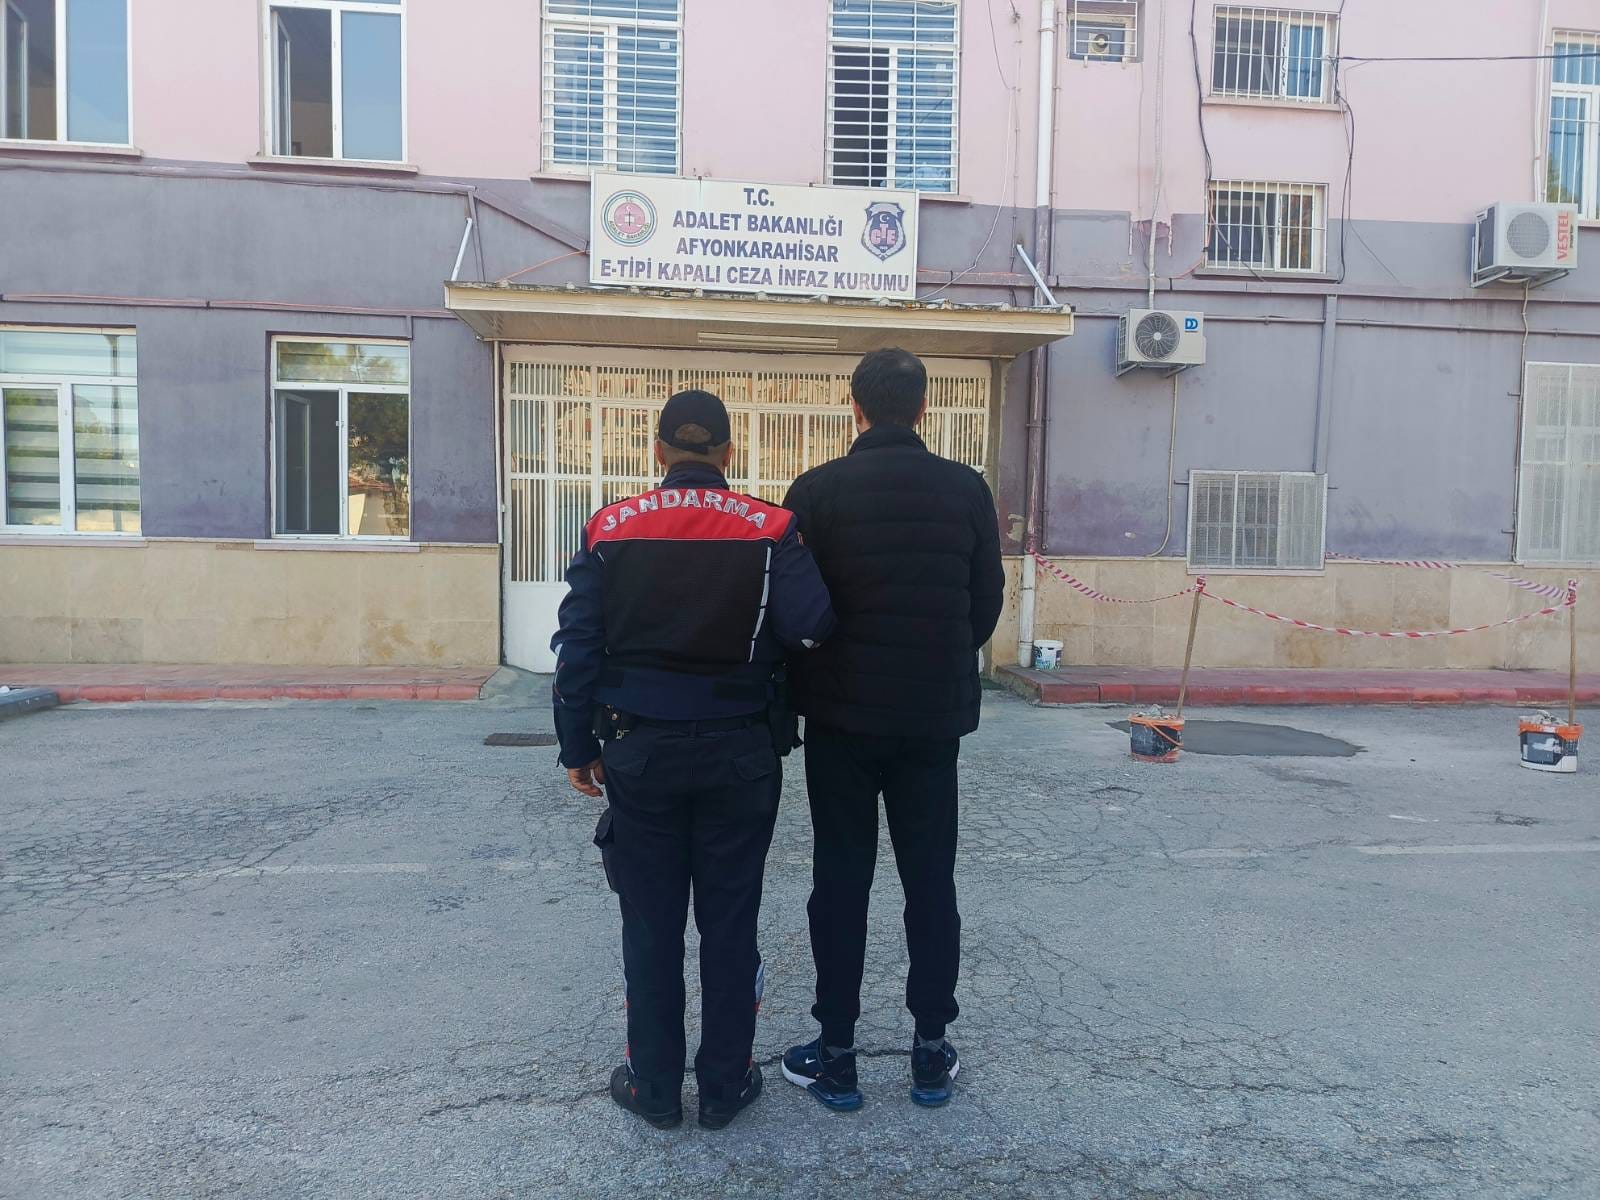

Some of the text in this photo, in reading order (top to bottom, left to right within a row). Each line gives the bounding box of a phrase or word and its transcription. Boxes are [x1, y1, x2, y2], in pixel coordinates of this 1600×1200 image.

[743, 187, 774, 206] T.C.
[672, 210, 843, 236] ADALET BAKANLIĞI
[870, 223, 897, 245] CTE
[1556, 211, 1569, 260] VESTEL
[676, 237, 839, 262] AFYONKARAHİSAR
[601, 256, 909, 292] E-TİPİ KAPALI CEZA İNFAZ KURUMU
[601, 488, 767, 532] JANDARMA
